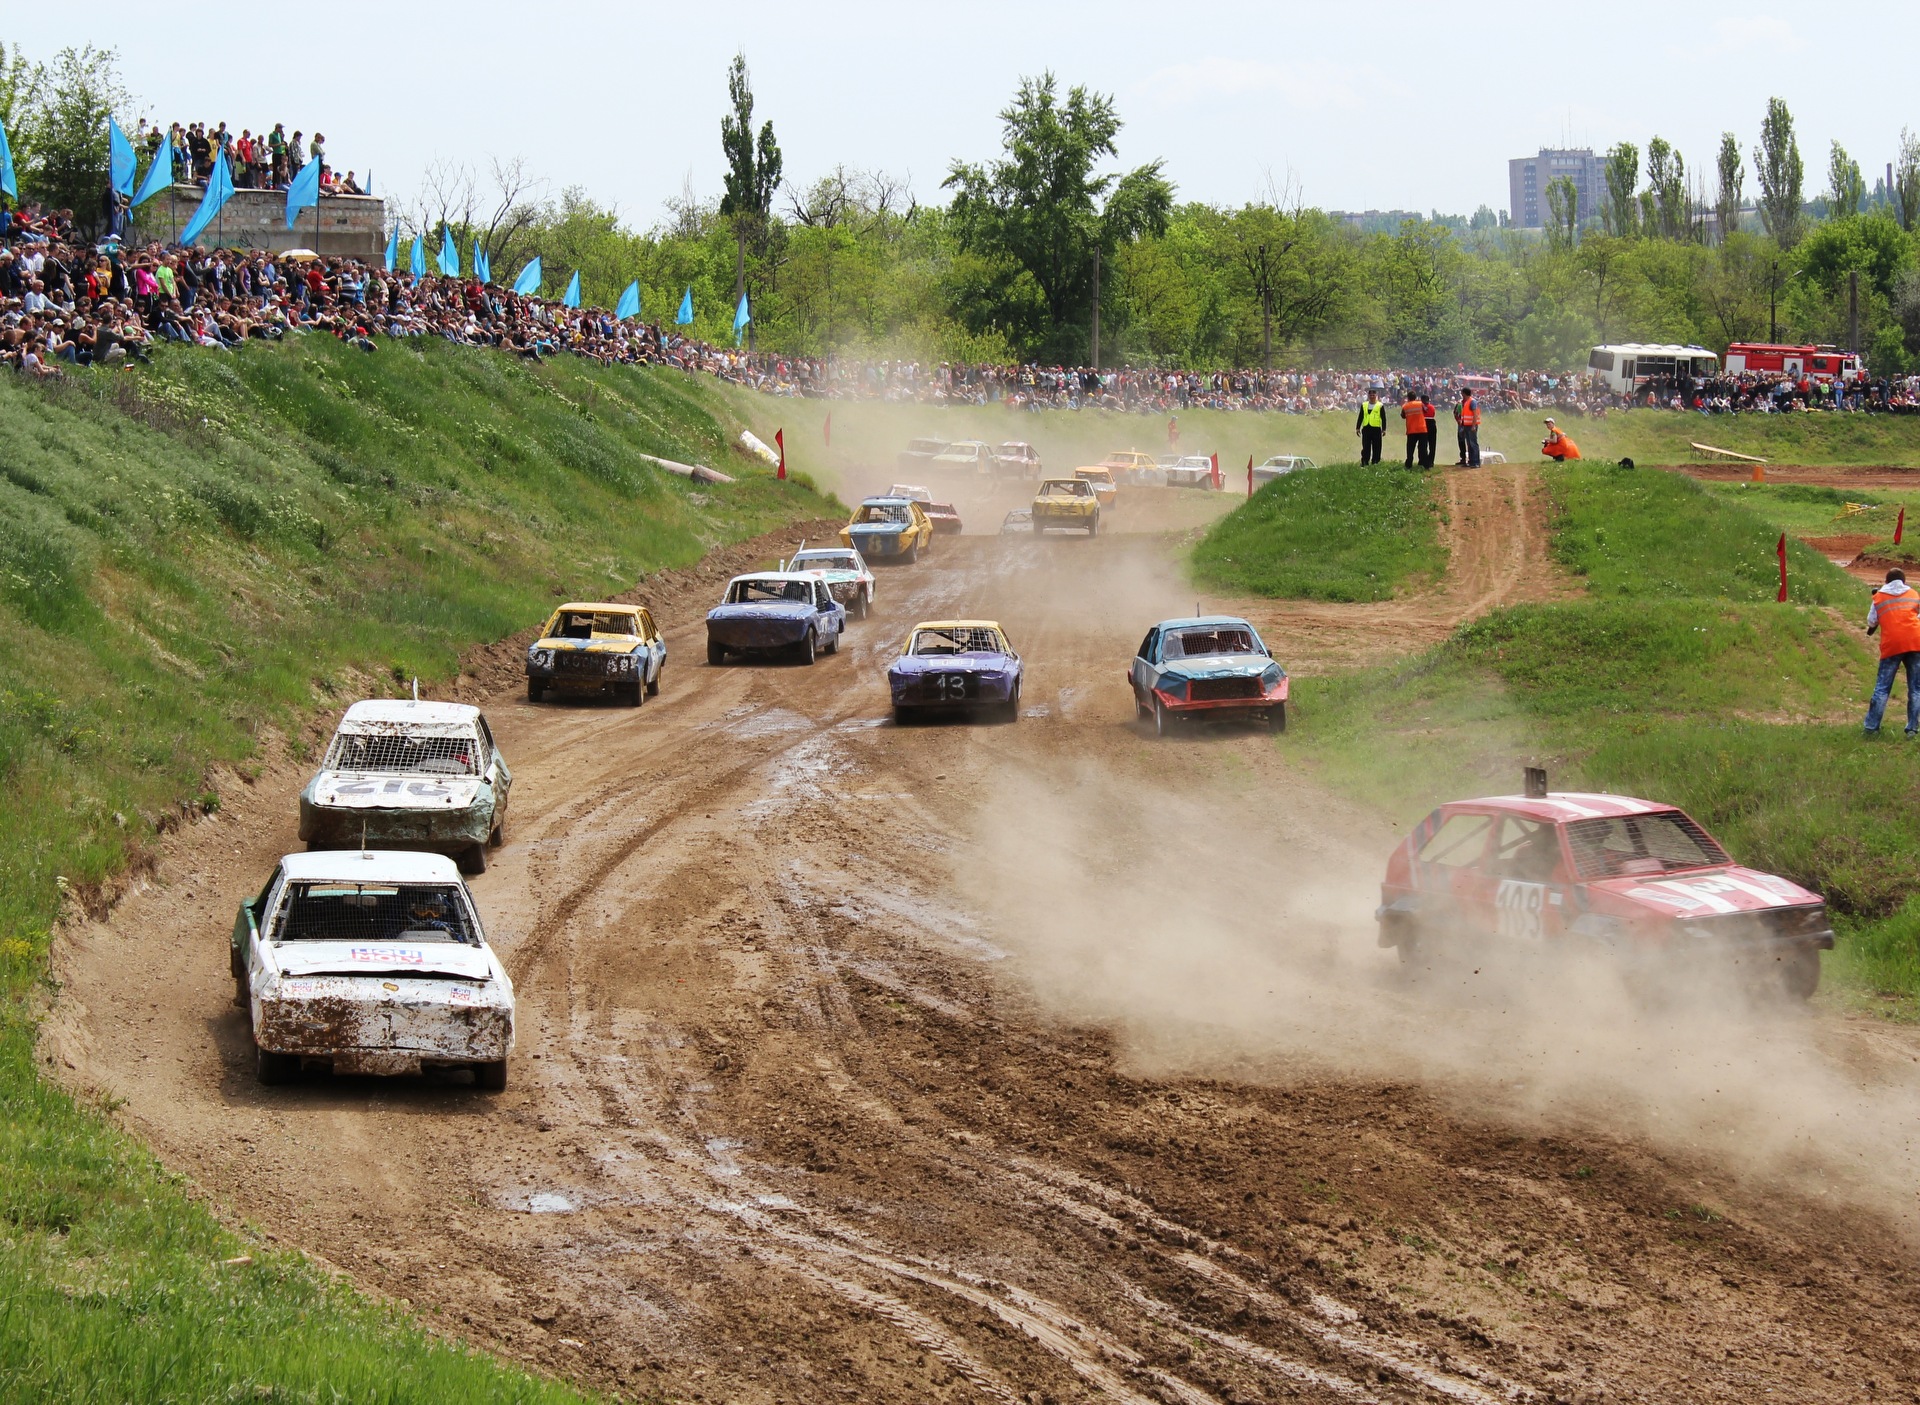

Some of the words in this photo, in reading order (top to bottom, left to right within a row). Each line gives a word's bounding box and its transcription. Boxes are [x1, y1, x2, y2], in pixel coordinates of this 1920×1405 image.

[937, 674, 966, 701] 13
[351, 948, 422, 957] LIQUI
[353, 952, 423, 963] MOLY
